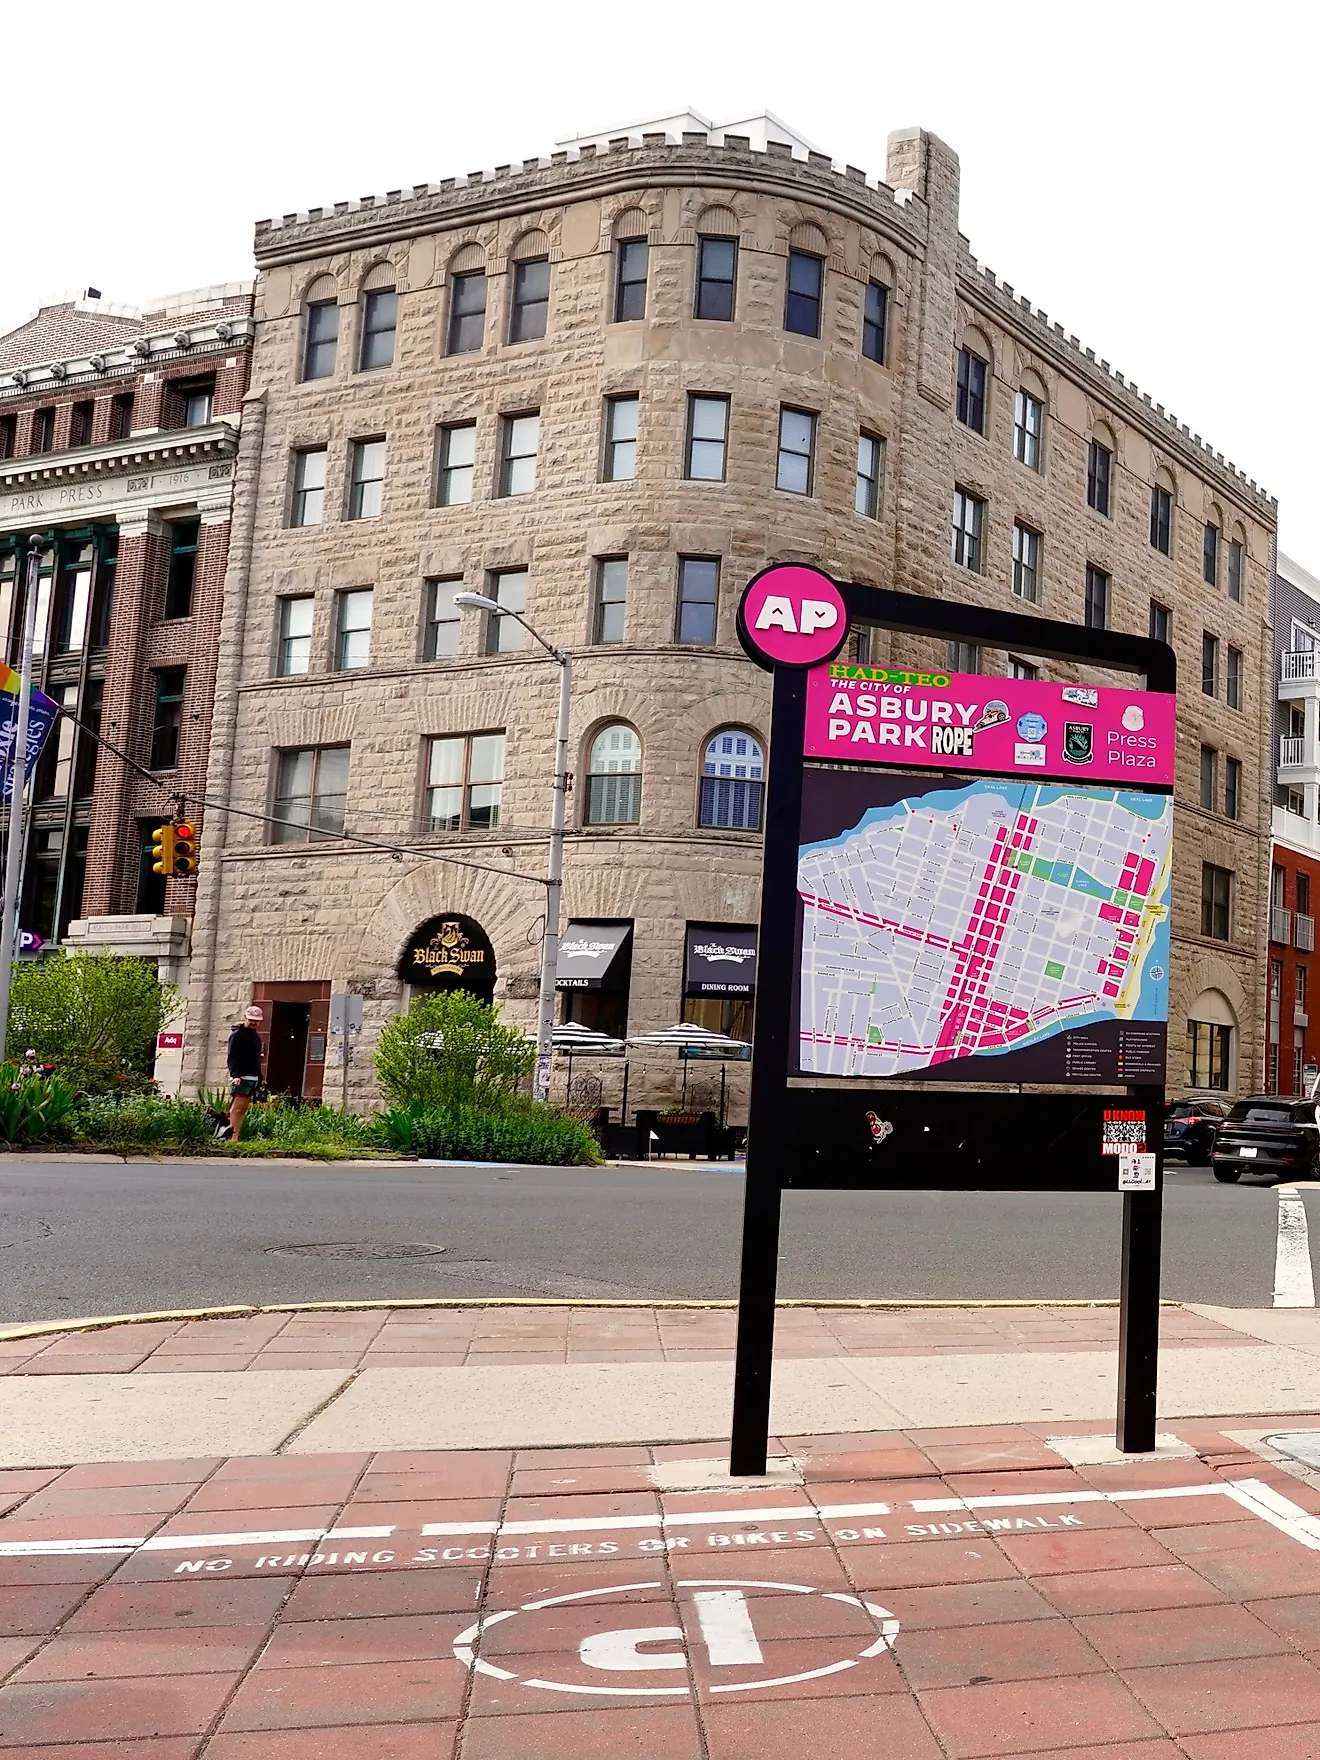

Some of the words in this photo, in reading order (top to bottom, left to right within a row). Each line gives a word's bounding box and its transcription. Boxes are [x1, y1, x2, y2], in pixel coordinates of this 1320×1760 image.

[169, 472, 189, 484] 1916
[11, 494, 44, 511] PARK
[59, 485, 103, 503] PRESS
[754, 595, 838, 635] AP
[829, 664, 950, 688] HAD-TEO
[830, 679, 856, 690] THE
[860, 681, 891, 693] CITY
[893, 684, 912, 694] OF
[828, 692, 979, 726] ASBURY
[828, 718, 928, 748] PARK
[932, 726, 974, 756] ROPE
[1107, 731, 1157, 749] Press
[1108, 750, 1157, 768] Plaza
[20, 931, 33, 948] P
[412, 946, 448, 965] Black
[448, 947, 484, 964] Swan
[555, 979, 589, 987] OCKTAILS
[701, 983, 727, 991] DINING
[728, 984, 750, 992] ROOM
[1103, 1110, 1112, 1121] U
[1112, 1109, 1146, 1121] KNOW
[174, 1557, 233, 1575] NO
[254, 1549, 396, 1569] RIDING
[414, 1540, 620, 1562] SCOOTERS
[638, 1535, 689, 1553] OR
[707, 1527, 817, 1549] BIKES
[838, 1523, 887, 1542] ON
[903, 1513, 1085, 1537] SIDEWALK
